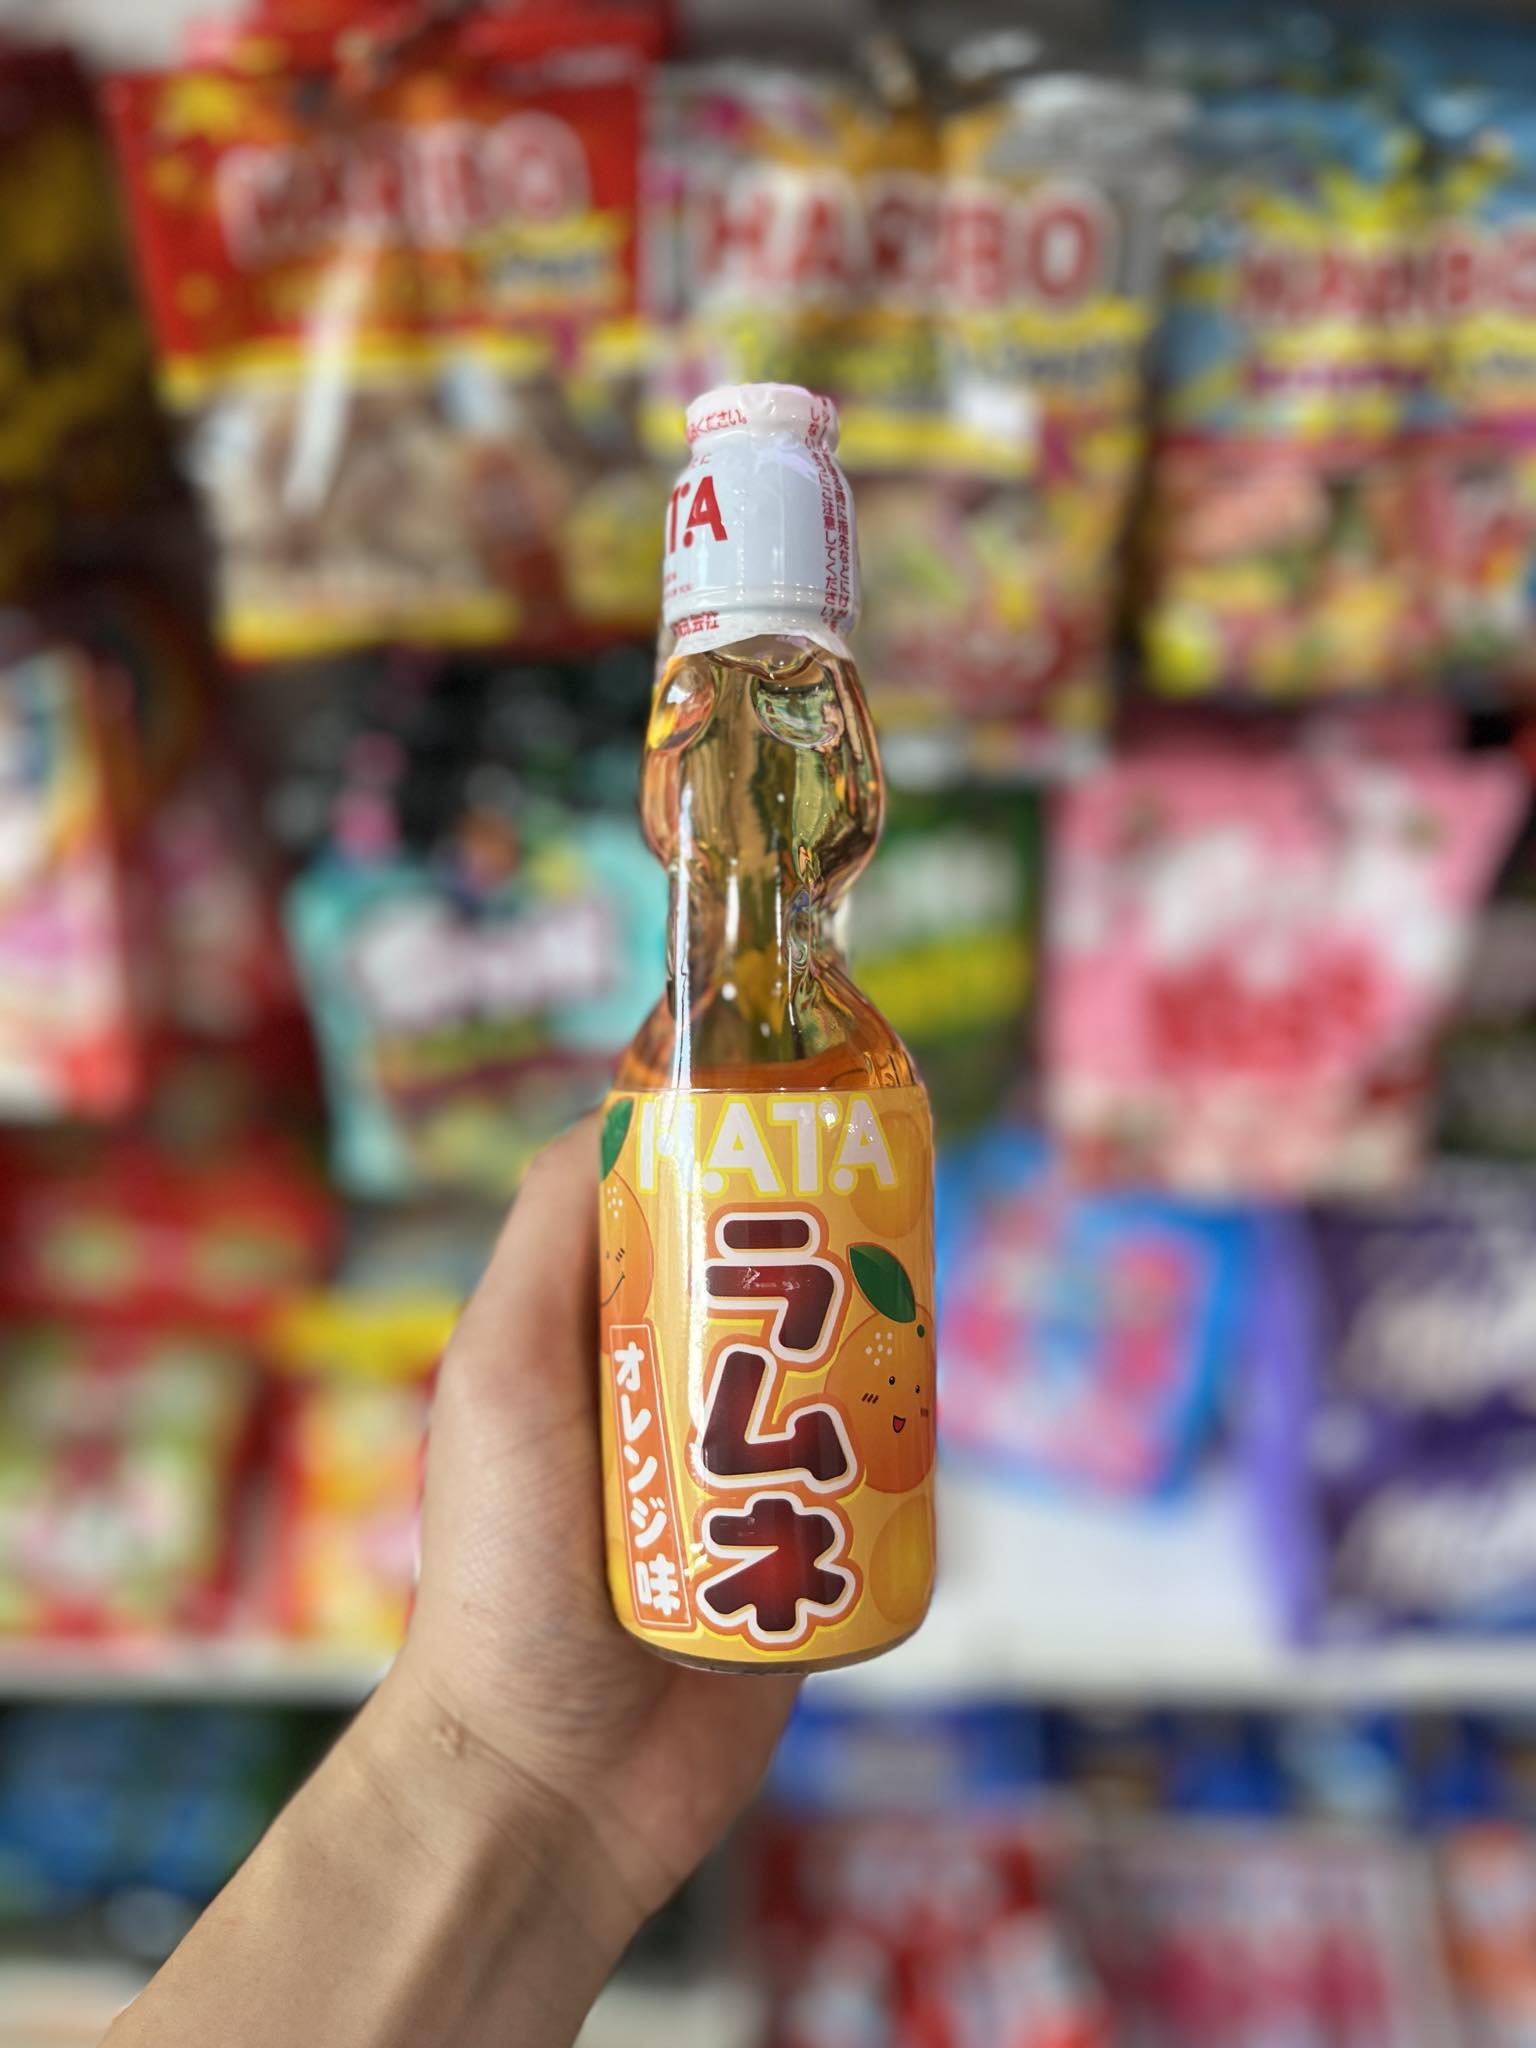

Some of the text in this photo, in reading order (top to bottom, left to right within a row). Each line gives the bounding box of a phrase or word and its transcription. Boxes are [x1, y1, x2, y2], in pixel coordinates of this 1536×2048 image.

[638, 1096, 898, 1196] HATA
[613, 1341, 681, 1616] オレンジ味
[697, 1211, 858, 1643] ラムネ
